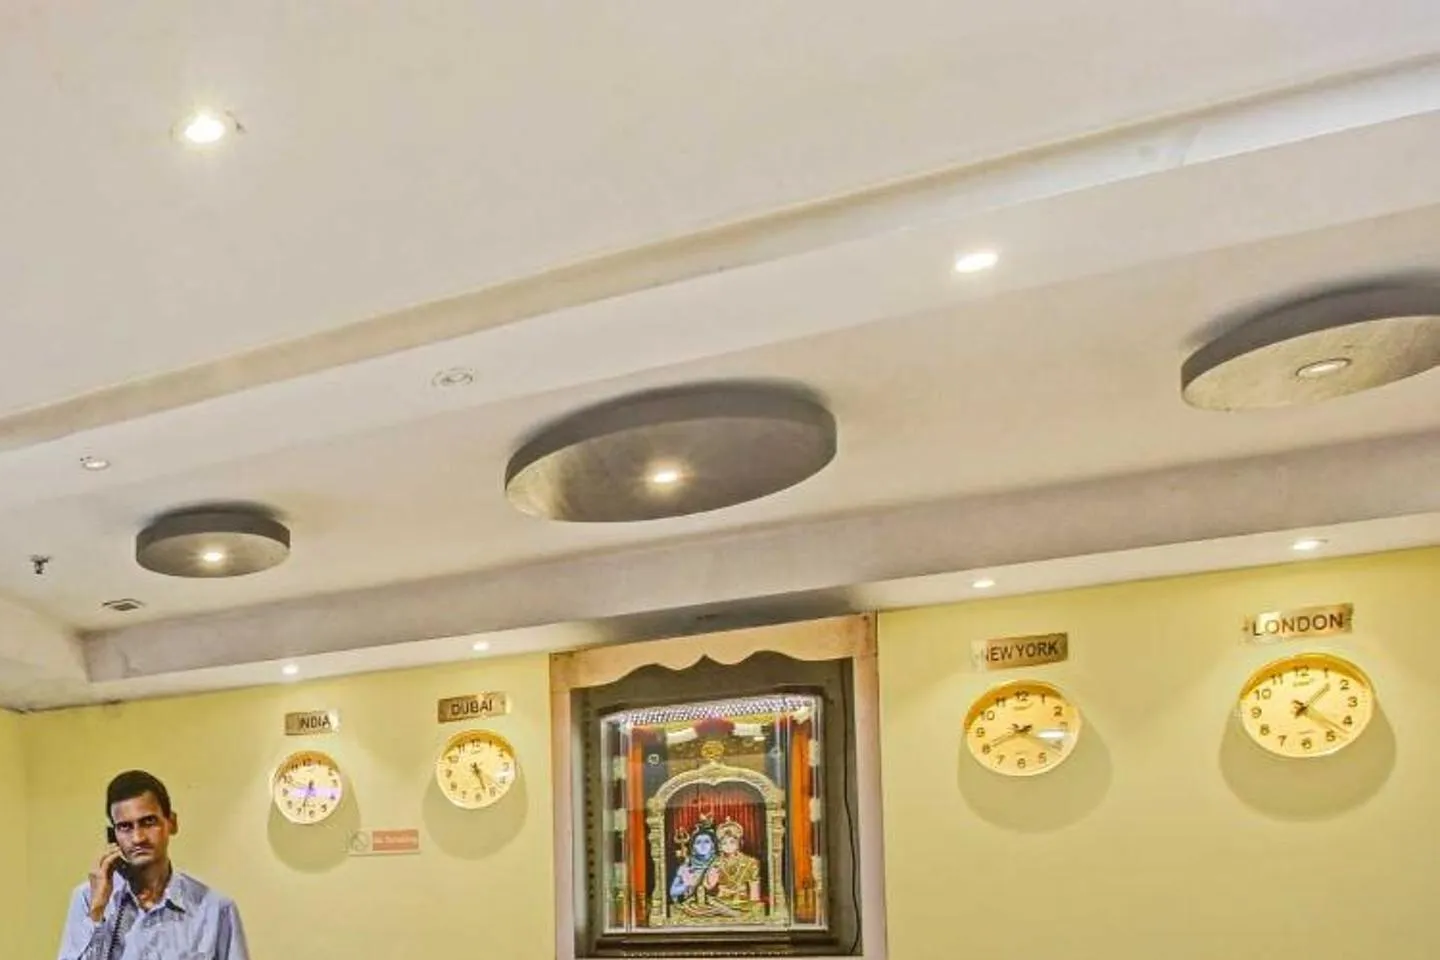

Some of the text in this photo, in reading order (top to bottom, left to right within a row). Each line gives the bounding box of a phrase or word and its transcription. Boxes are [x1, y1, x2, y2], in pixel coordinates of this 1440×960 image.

[1252, 612, 1343, 636] LONDON
[1293, 664, 1310, 677] 12
[1340, 678, 1349, 690] 2
[1254, 688, 1271, 700] 10
[451, 699, 493, 716] DUBAI
[1348, 696, 1358, 707] 3
[1053, 705, 1063, 717] 2
[1251, 707, 1262, 718] 9
[1342, 715, 1353, 726] 4
[1278, 735, 1287, 747] 7
[1326, 729, 1336, 742] 5
